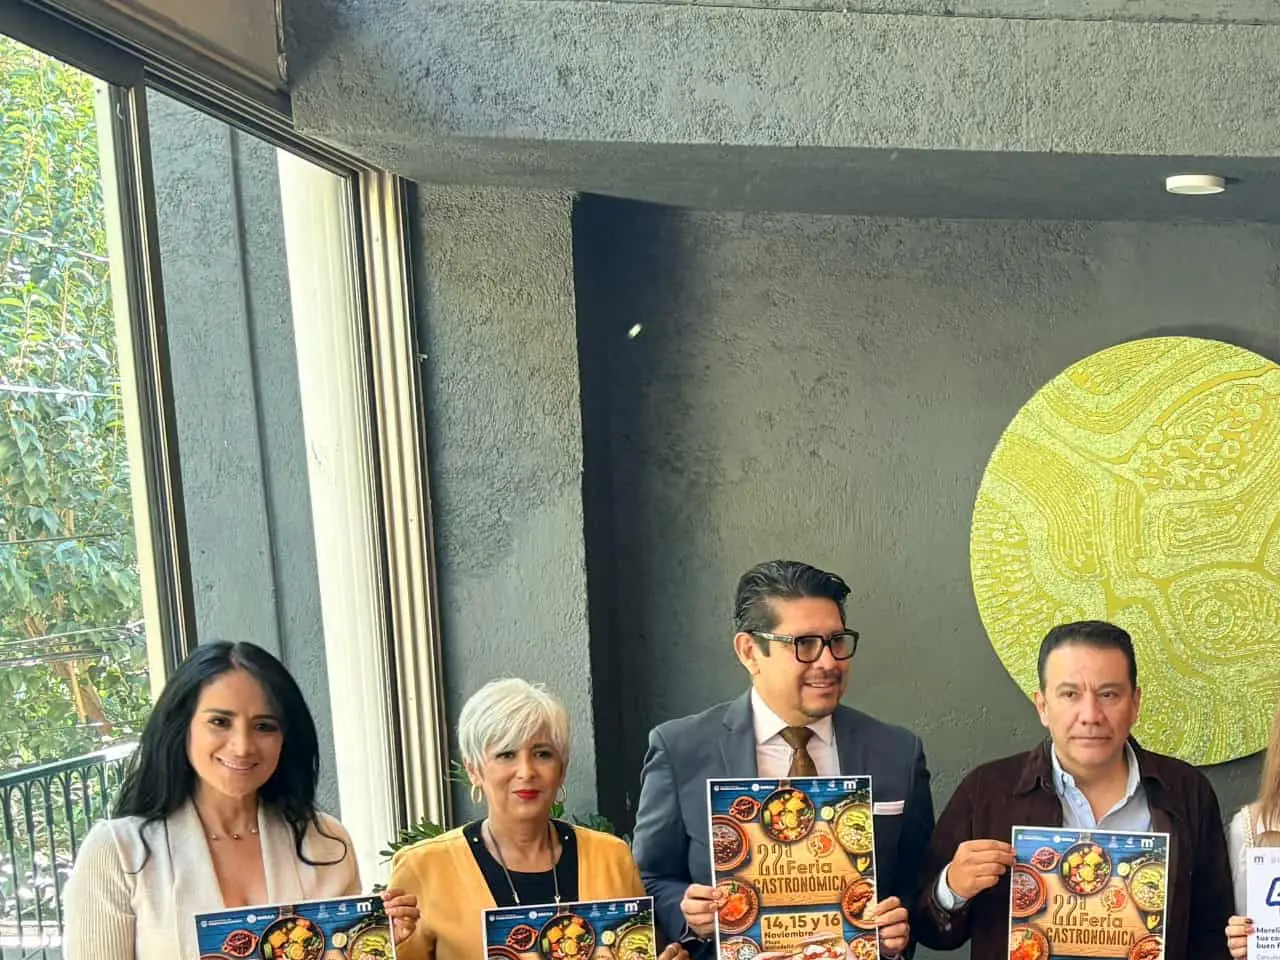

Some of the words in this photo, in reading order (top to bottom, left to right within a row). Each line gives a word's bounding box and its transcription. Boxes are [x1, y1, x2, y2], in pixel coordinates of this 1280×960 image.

[787, 860, 832, 874] Feria
[753, 875, 847, 894] GASTRONÓMICA
[812, 917, 821, 930] y
[822, 914, 840, 926] 16
[1080, 913, 1122, 928] Feria
[764, 931, 814, 939] Noviembre
[1047, 927, 1135, 946] GASTRONÓMICA
